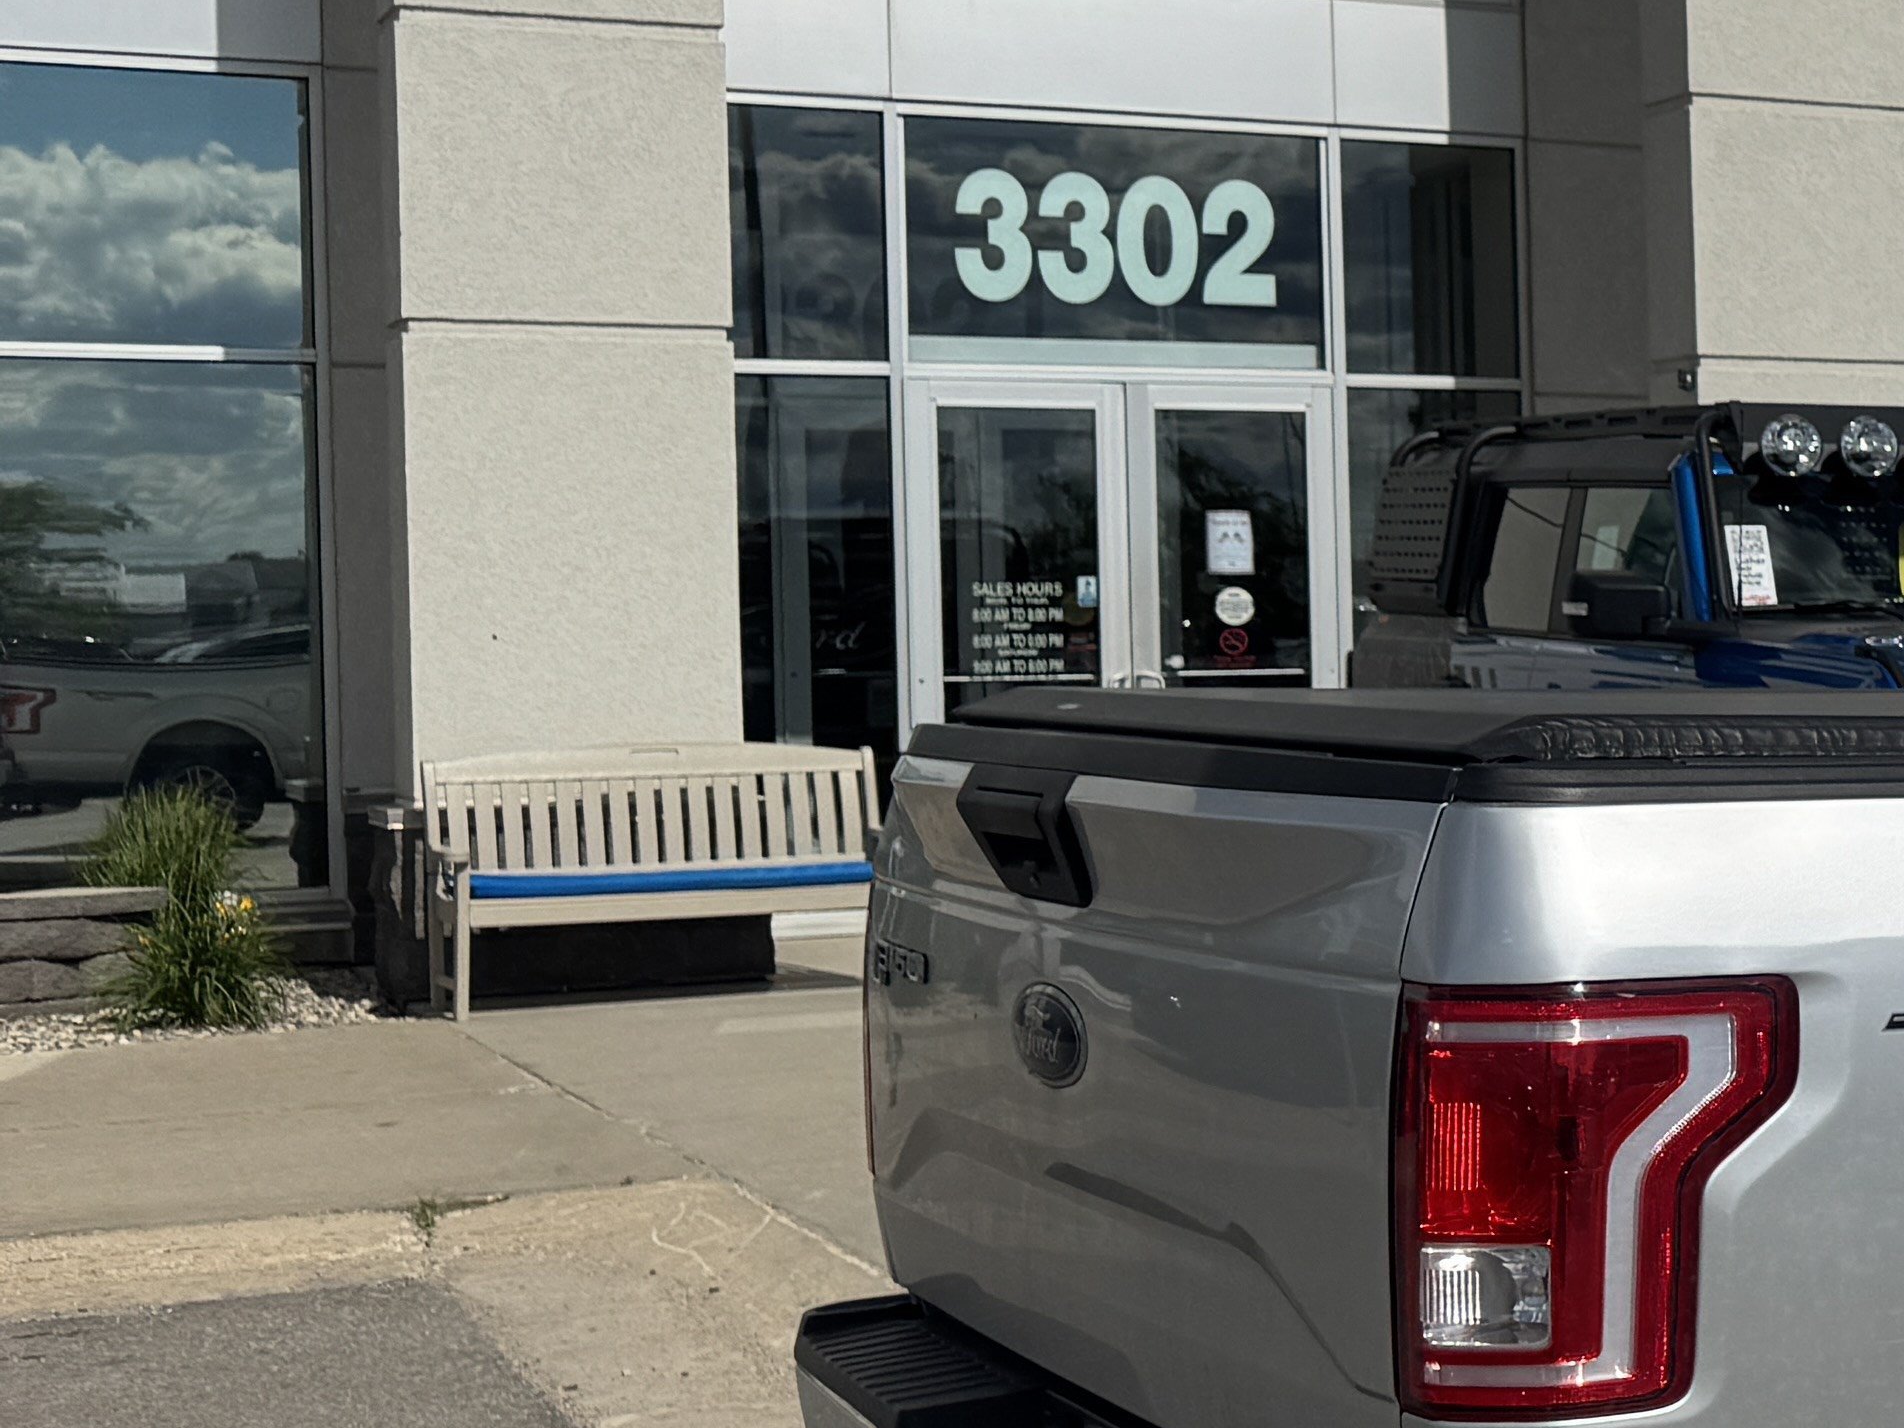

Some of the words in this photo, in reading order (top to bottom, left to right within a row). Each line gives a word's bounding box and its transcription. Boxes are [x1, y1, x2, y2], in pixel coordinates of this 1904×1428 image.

[953, 167, 1277, 307] 3302
[972, 581, 1013, 597] SALES
[1016, 581, 1064, 597] HOURS
